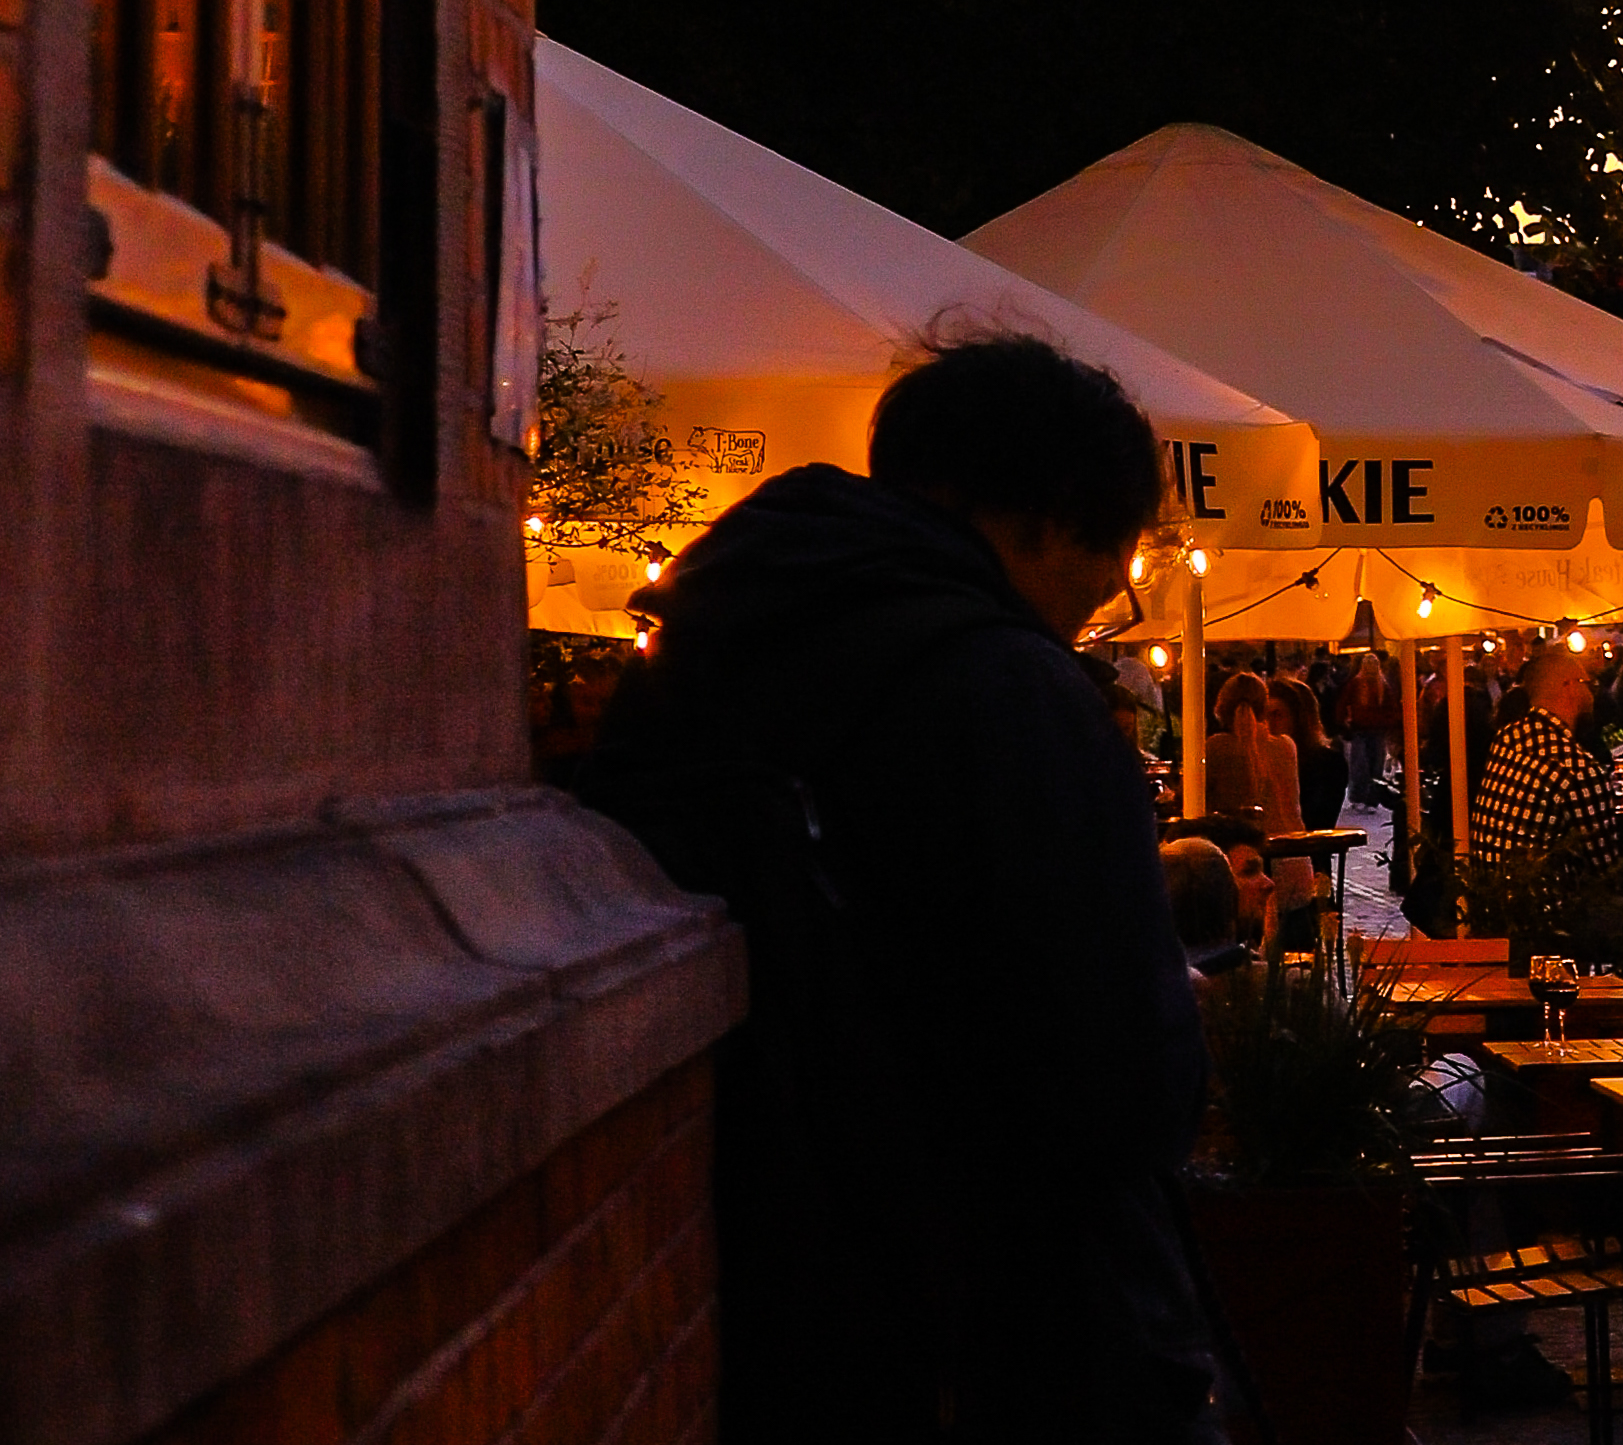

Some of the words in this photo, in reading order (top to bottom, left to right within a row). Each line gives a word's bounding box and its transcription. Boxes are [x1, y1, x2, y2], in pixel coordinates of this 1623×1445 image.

[714, 432, 759, 452] T-Bone
[1272, 499, 1306, 519] 100%
[1512, 505, 1570, 523] 100%
